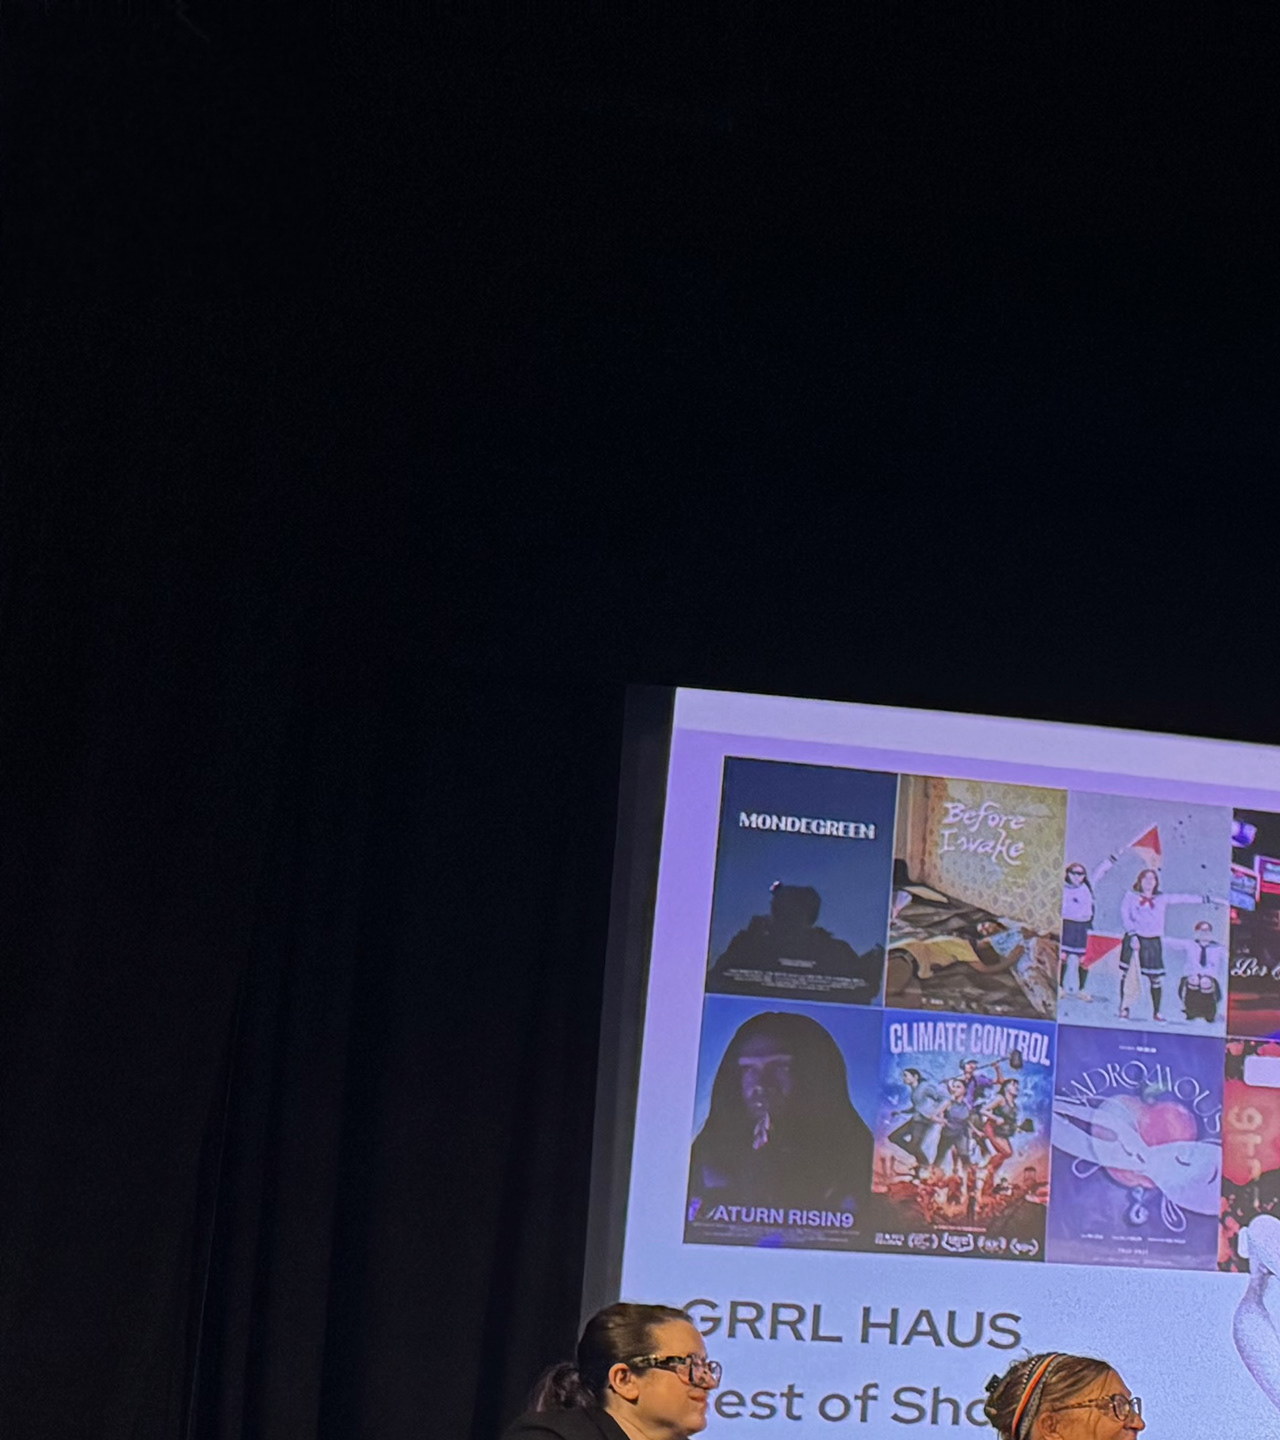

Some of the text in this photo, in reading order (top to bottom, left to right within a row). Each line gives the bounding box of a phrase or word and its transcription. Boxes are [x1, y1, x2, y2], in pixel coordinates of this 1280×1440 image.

[739, 811, 876, 840] MONDEGREEN
[942, 801, 1026, 833] Before
[889, 1021, 1051, 1067] CLIMATE CONTROL
[706, 1204, 784, 1225] ATURN
[684, 1298, 1023, 1351] GRRL HAUS
[714, 1382, 991, 1427] est of Sho
